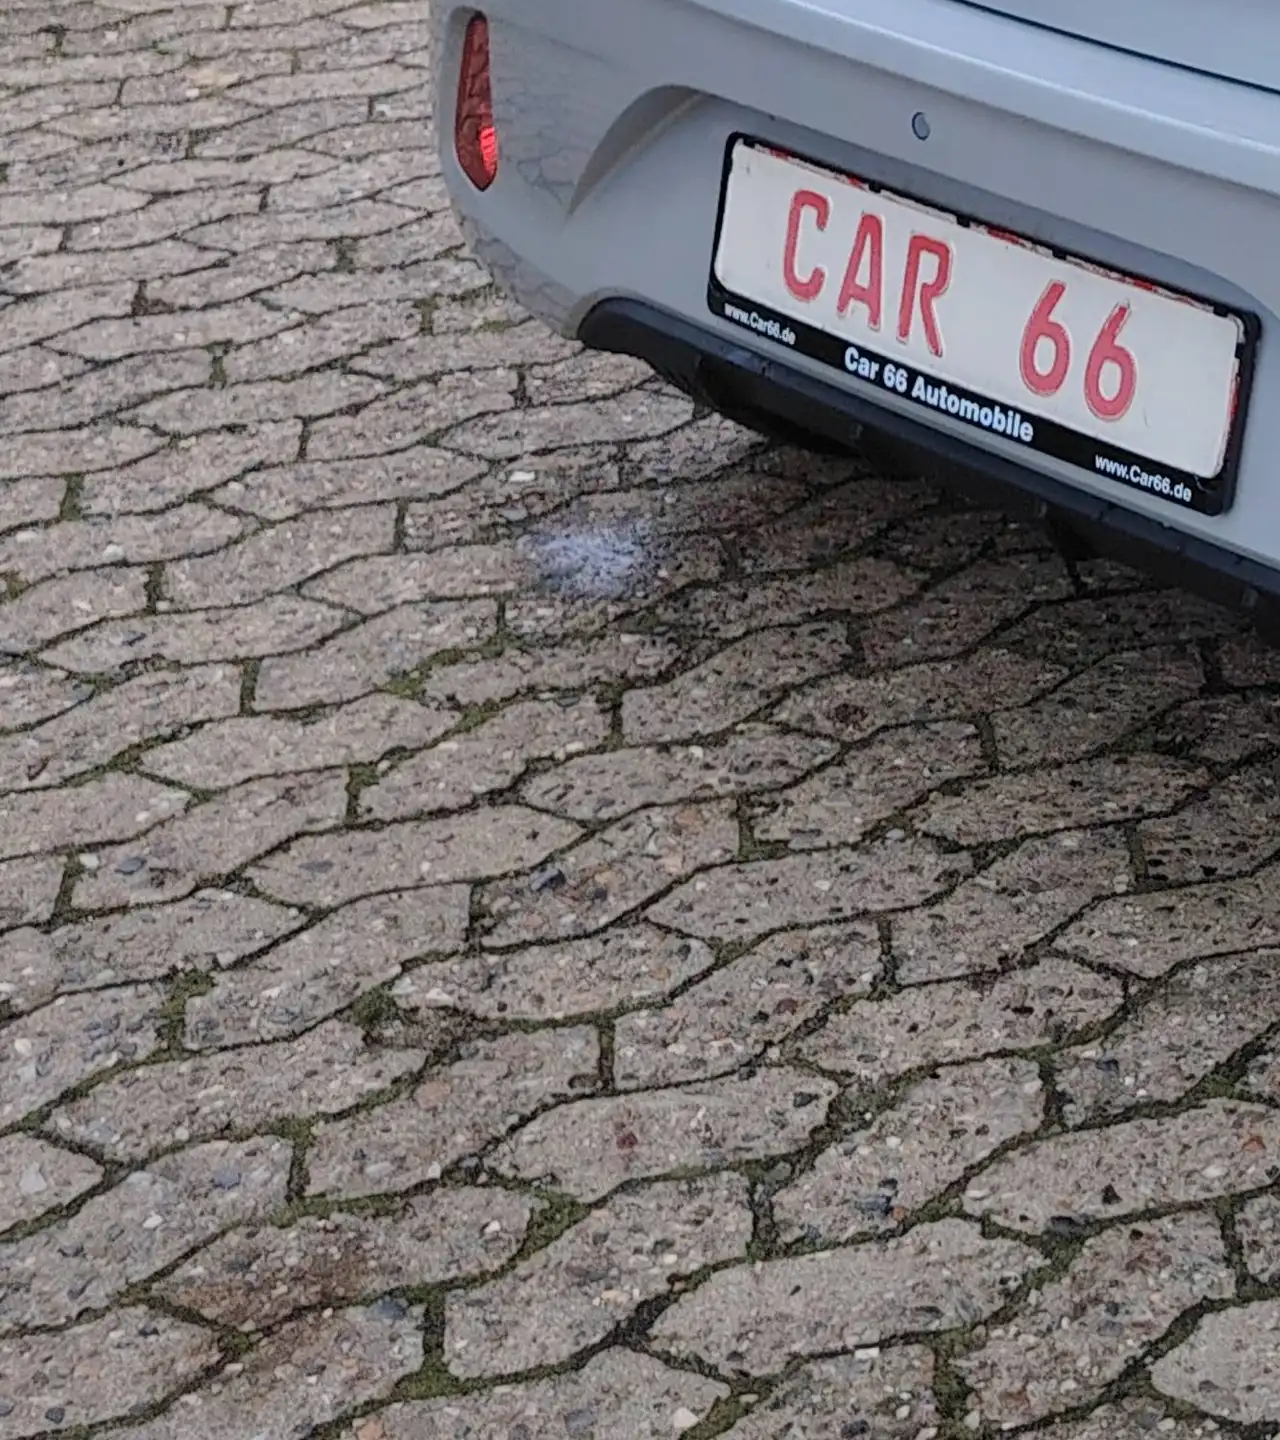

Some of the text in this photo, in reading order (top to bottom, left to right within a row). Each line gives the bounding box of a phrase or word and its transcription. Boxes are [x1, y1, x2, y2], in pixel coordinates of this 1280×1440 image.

[723, 302, 796, 346] www.Car66.de
[783, 189, 1138, 423] CAR 66
[844, 346, 1035, 443] Car 66 Automobile
[1094, 453, 1193, 503] www.Car66.de
